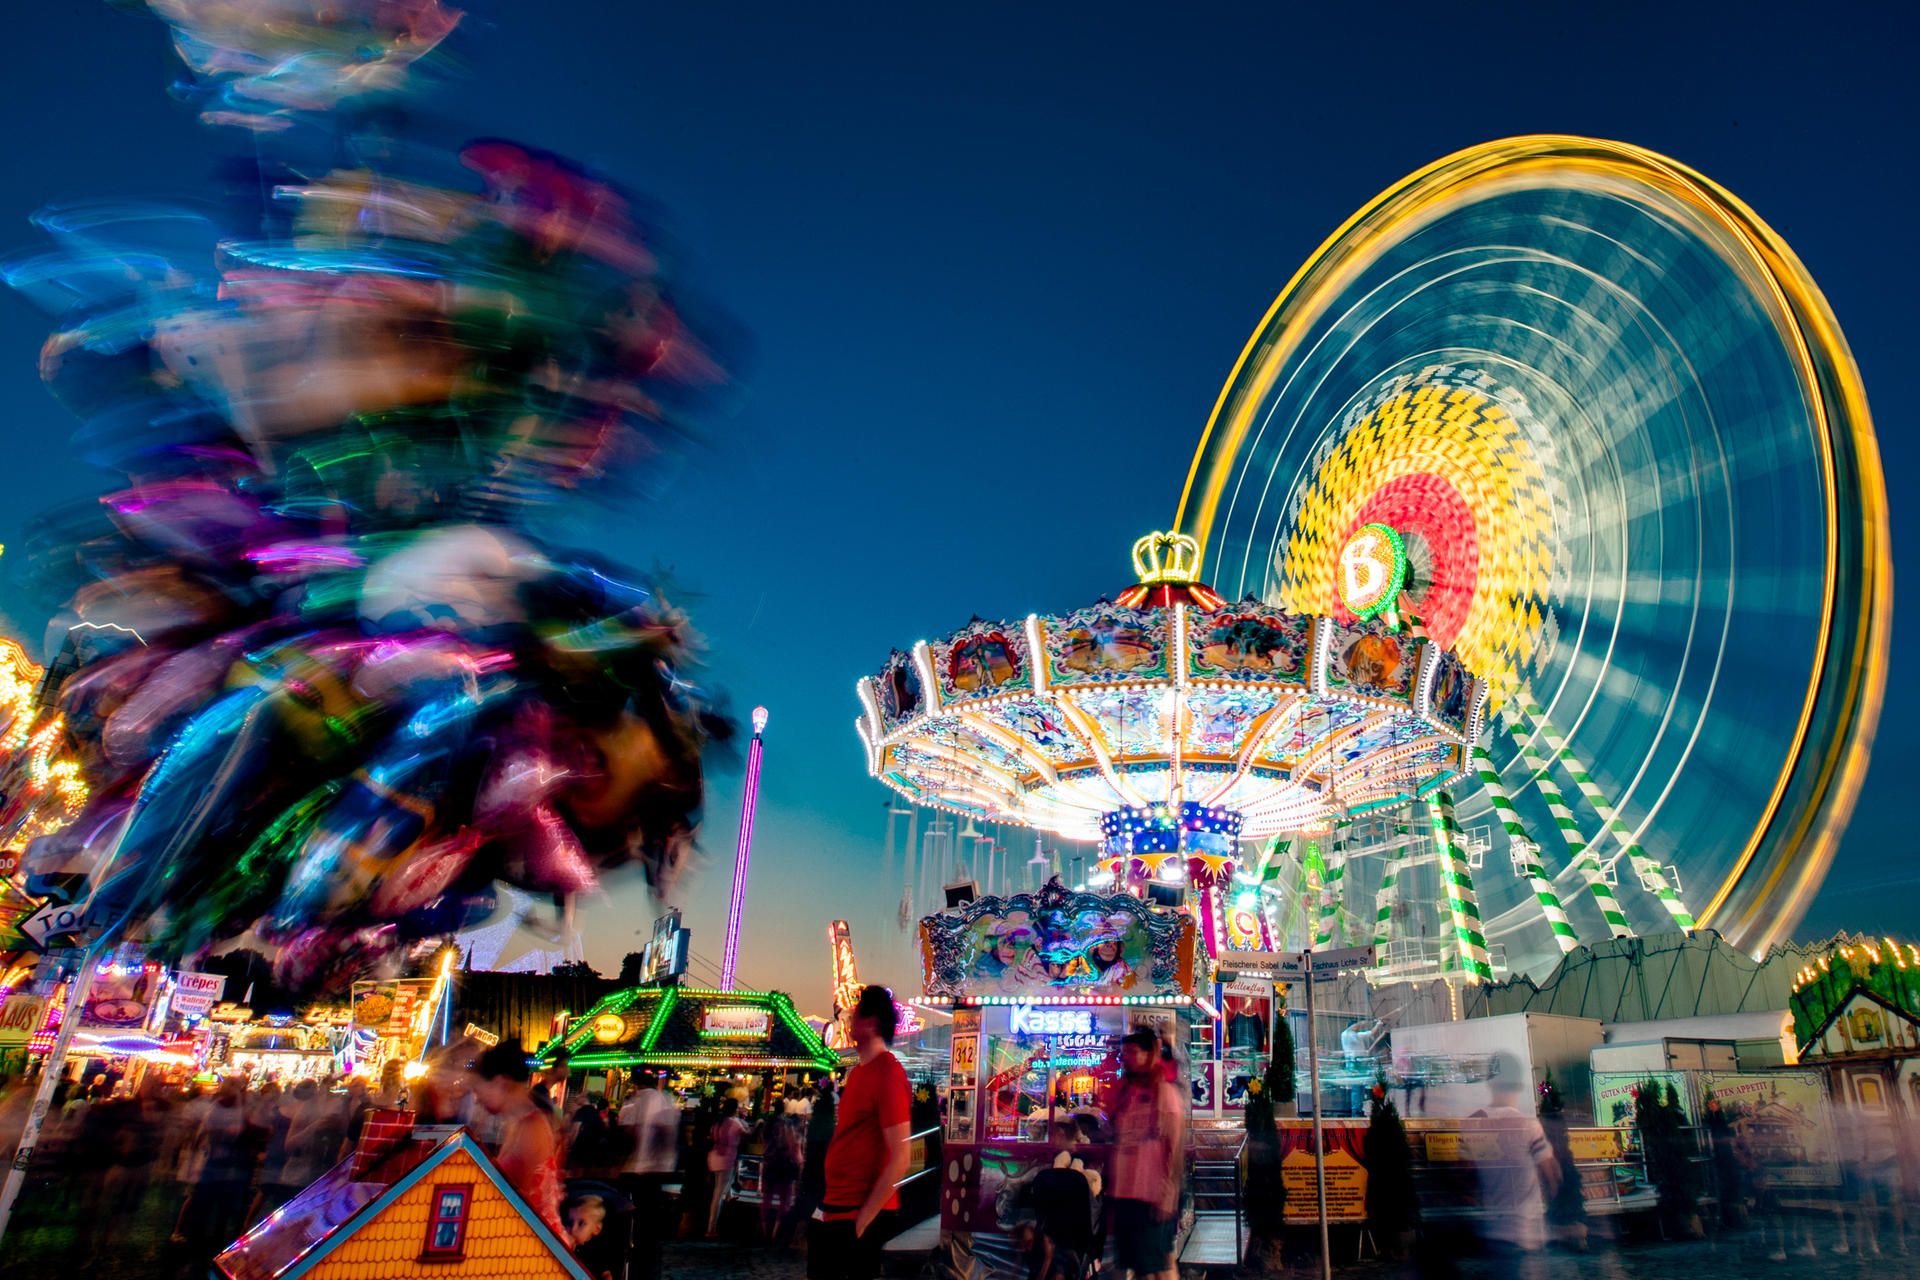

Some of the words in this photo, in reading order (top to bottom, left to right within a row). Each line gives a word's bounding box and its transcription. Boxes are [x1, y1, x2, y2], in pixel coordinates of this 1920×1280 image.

[1236, 912, 1254, 935] C
[1222, 960, 1259, 969] Fleischerei
[1260, 961, 1280, 970] Sabel
[1010, 1004, 1093, 1034] Kasse
[1712, 1087, 1735, 1098] UTEN
[1736, 1081, 1769, 1095] APPETIT
